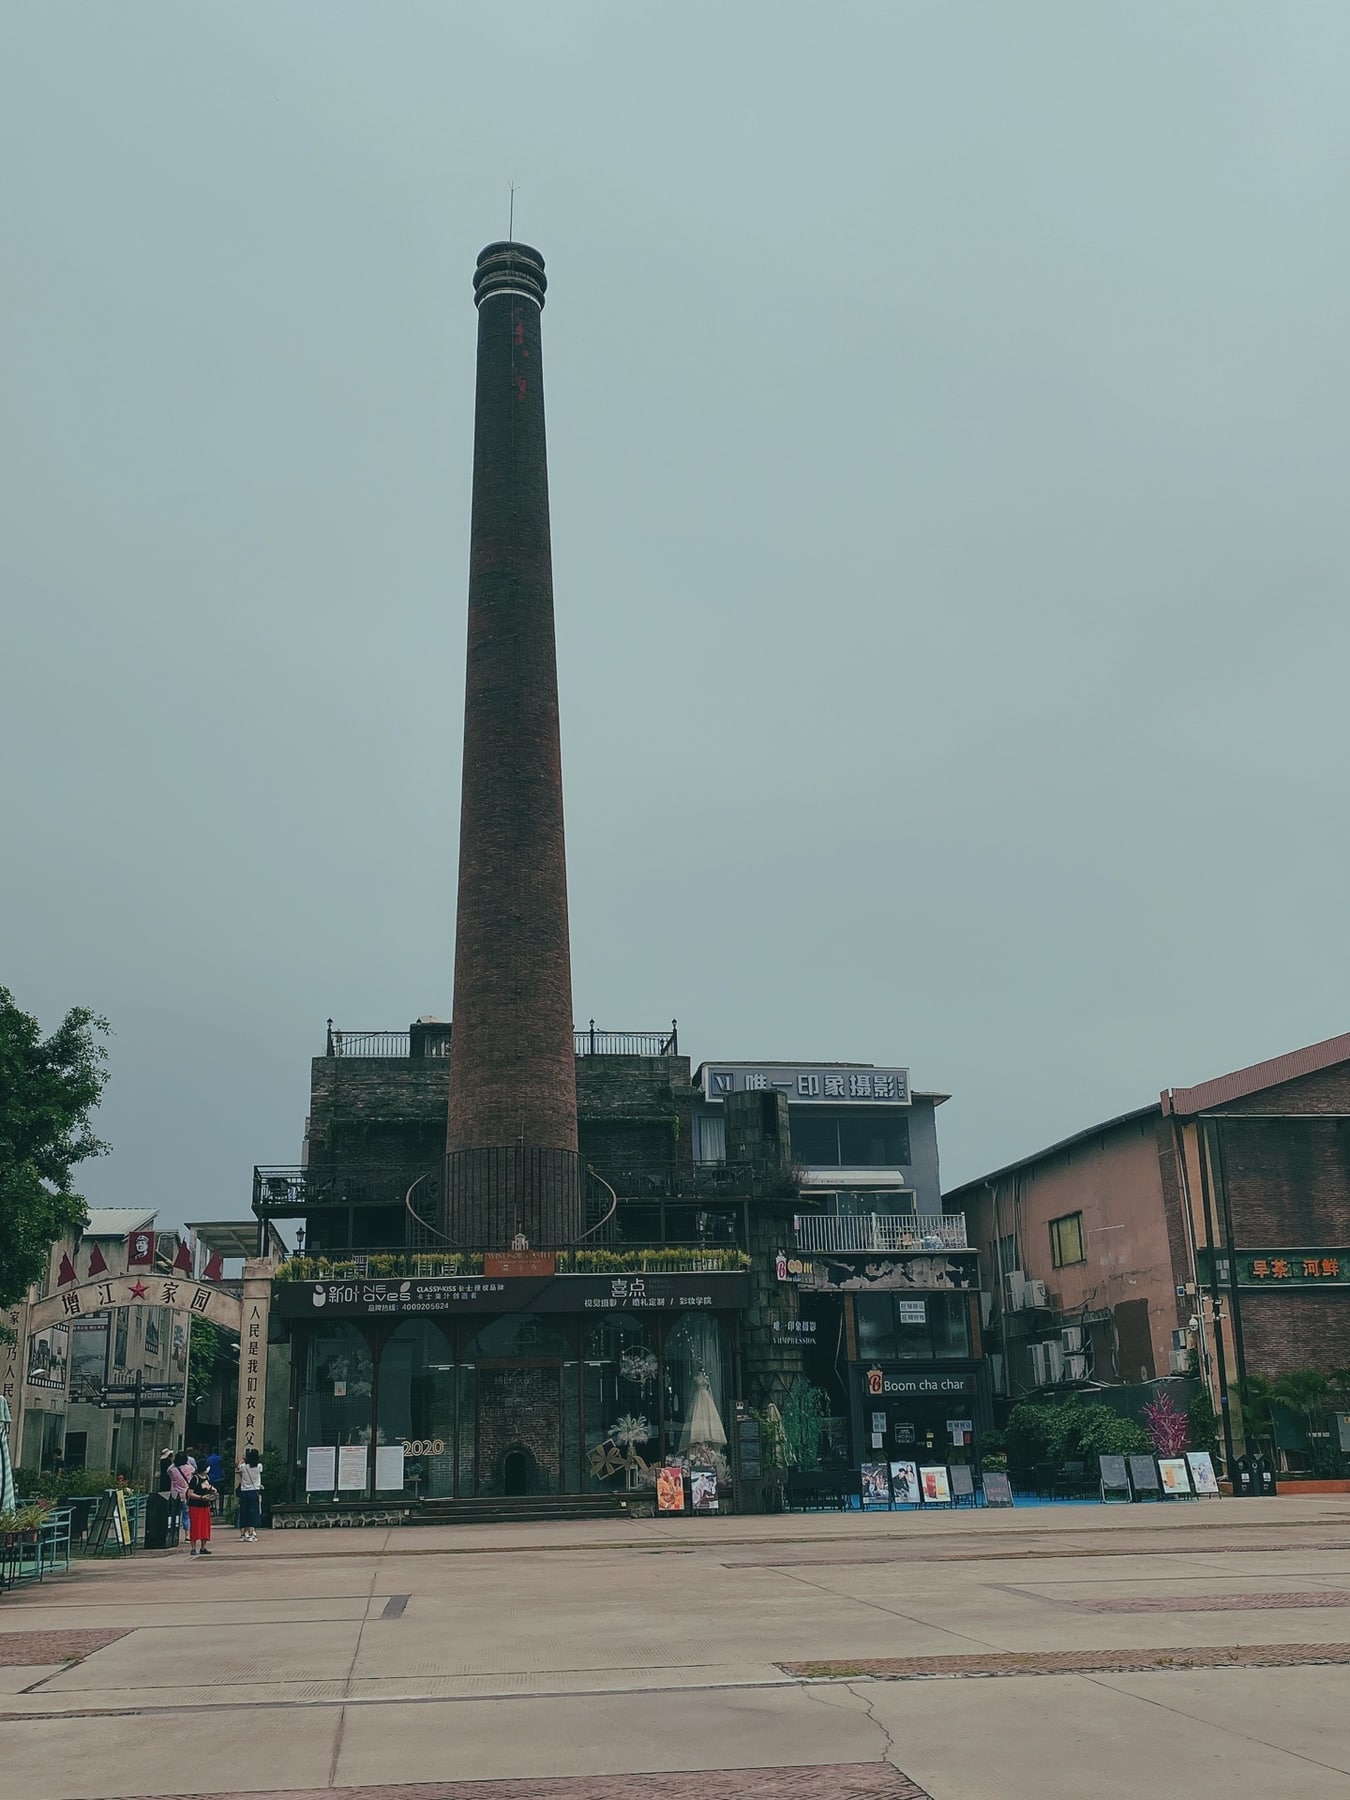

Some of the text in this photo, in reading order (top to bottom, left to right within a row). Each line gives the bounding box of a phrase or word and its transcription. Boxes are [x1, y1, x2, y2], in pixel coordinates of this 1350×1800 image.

[744, 1073, 895, 1097] 唯一印象摄影
[1252, 1258, 1340, 1279] 早茶 河鲜
[61, 1281, 212, 1315] 增江 家园
[328, 1284, 360, 1303] 新叶
[610, 1278, 647, 1298] 喜点
[243, 1304, 262, 1456] 人民是我们衣食父
[883, 1380, 916, 1392] Boom
[919, 1379, 938, 1391] cha
[941, 1378, 965, 1390] char
[400, 1438, 445, 1457] 2020
